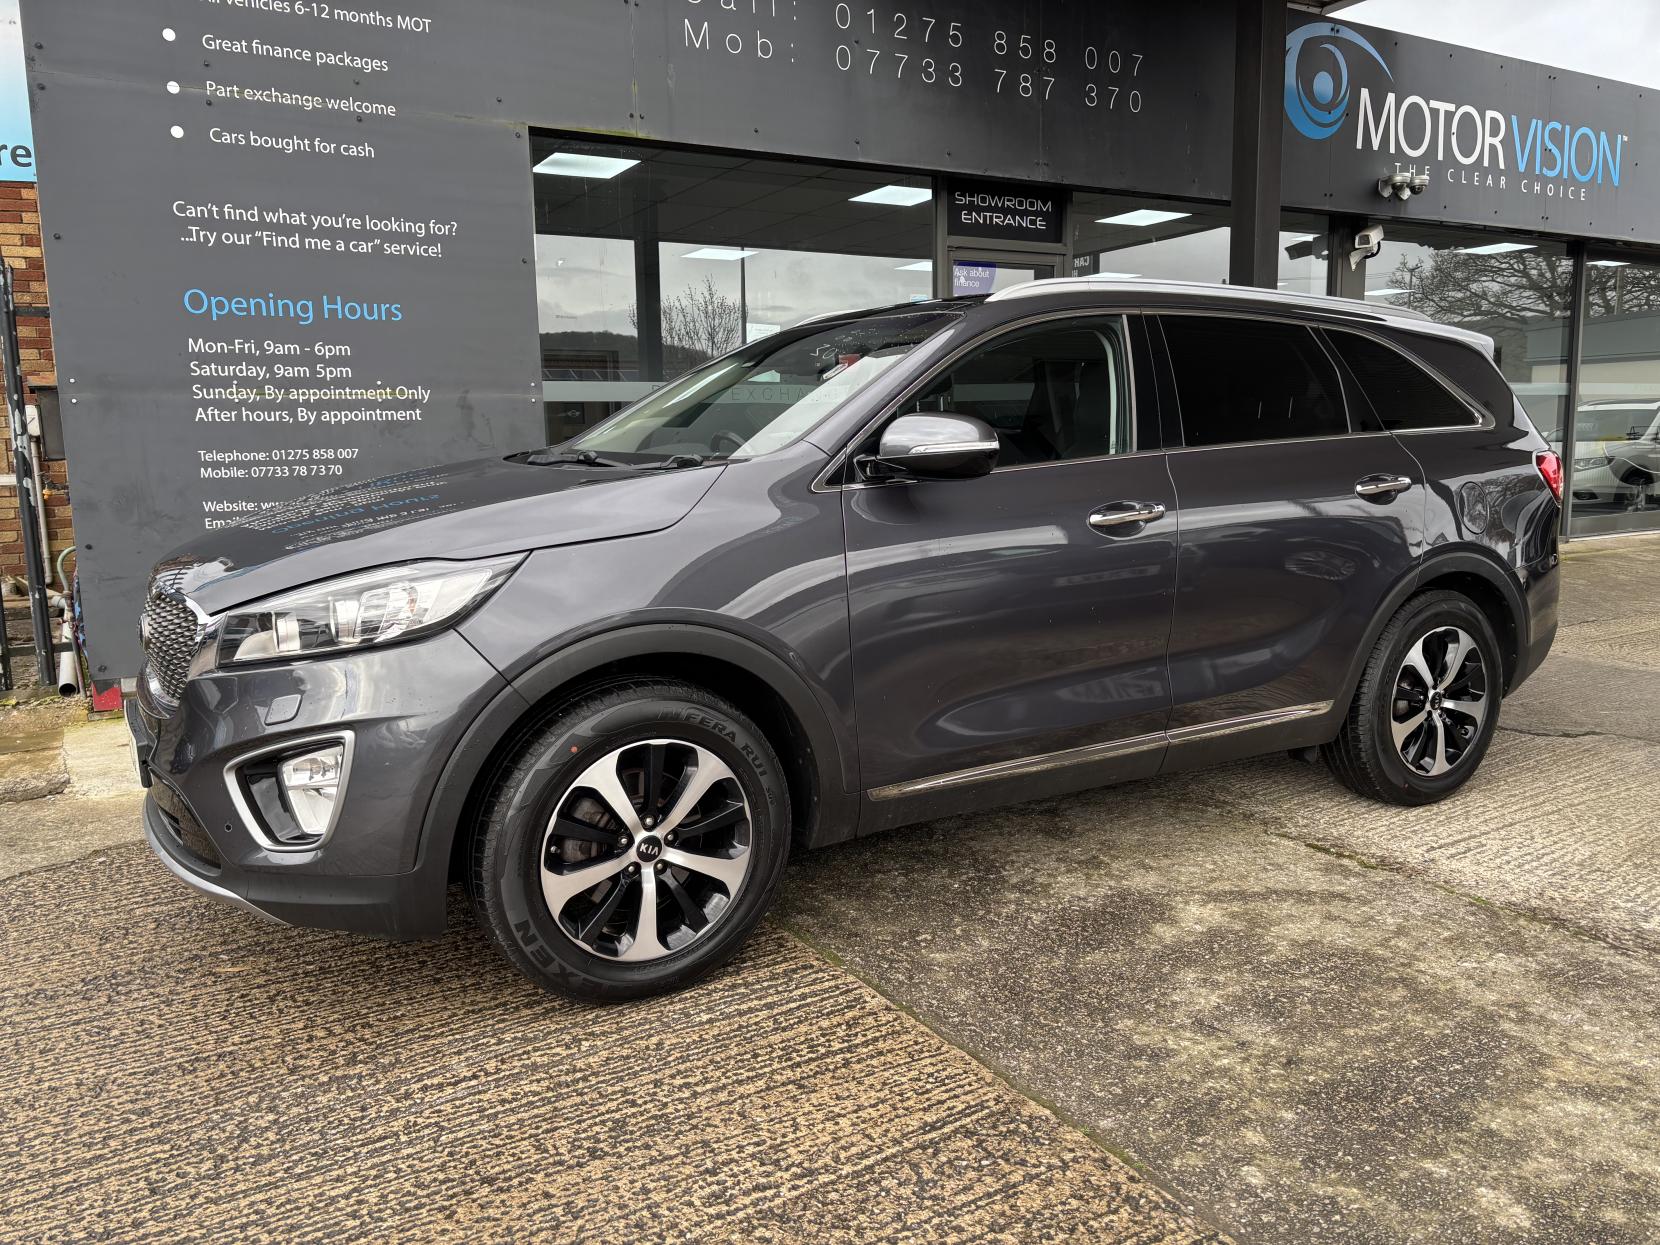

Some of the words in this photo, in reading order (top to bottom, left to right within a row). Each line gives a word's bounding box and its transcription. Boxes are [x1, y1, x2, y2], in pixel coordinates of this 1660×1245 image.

[294, 0, 330, 19] 6-12
[334, 9, 394, 28] months
[397, 14, 432, 33] MOT
[835, 2, 963, 48] 01275
[993, 30, 1057, 64] 858
[1084, 46, 1144, 77] 007
[201, 34, 249, 54] Great
[251, 39, 312, 62] finance
[315, 50, 389, 73] packages
[684, 15, 797, 63] Mob:
[835, 44, 963, 87] 07733
[994, 68, 1055, 101] 787
[1084, 83, 1142, 113] 370
[206, 80, 240, 99] Part
[243, 87, 323, 111] exchange
[325, 96, 397, 117] welcome
[209, 127, 246, 145] Cars
[249, 130, 312, 154] bought
[313, 137, 337, 154] for
[340, 142, 375, 159] cash
[1394, 162, 1431, 181] THE
[1447, 168, 1506, 190] CLEAR
[1521, 179, 1586, 201] CHOICE
[954, 191, 1052, 213] SHOWROOM
[222, 203, 259, 222] find
[262, 207, 308, 226] what
[365, 214, 426, 238] looking
[428, 219, 458, 236] for?
[961, 210, 1047, 230] ENTRANCE
[221, 232, 253, 246] our
[304, 237, 332, 251] me
[335, 239, 345, 252] a
[383, 241, 442, 258] service!
[954, 268, 968, 277] Ask
[969, 267, 990, 278] about
[954, 278, 980, 288] finance
[183, 288, 314, 325] Opening
[322, 295, 403, 321] Hours
[188, 337, 260, 357] Mon-Fri,
[263, 340, 301, 355] 9am
[314, 341, 351, 360] 6pm
[189, 360, 270, 381] Saturday,
[273, 363, 310, 378] 9am
[316, 363, 352, 382] 5pm
[192, 385, 260, 404] Sunday,
[264, 385, 285, 403] By
[288, 386, 392, 404] appointment
[395, 386, 431, 403] Only
[194, 406, 238, 422] After
[241, 406, 294, 424] hours,
[297, 407, 317, 426] By
[320, 407, 423, 425] appointment
[196, 449, 270, 464] Telephone:
[271, 448, 310, 461] 01275
[312, 448, 335, 460] 858
[336, 448, 359, 459] 007
[200, 466, 249, 479] Mobile:
[250, 465, 290, 478] 07733
[202, 500, 258, 512] Website:
[205, 517, 241, 530] Ema
[639, 842, 659, 856] KIA
